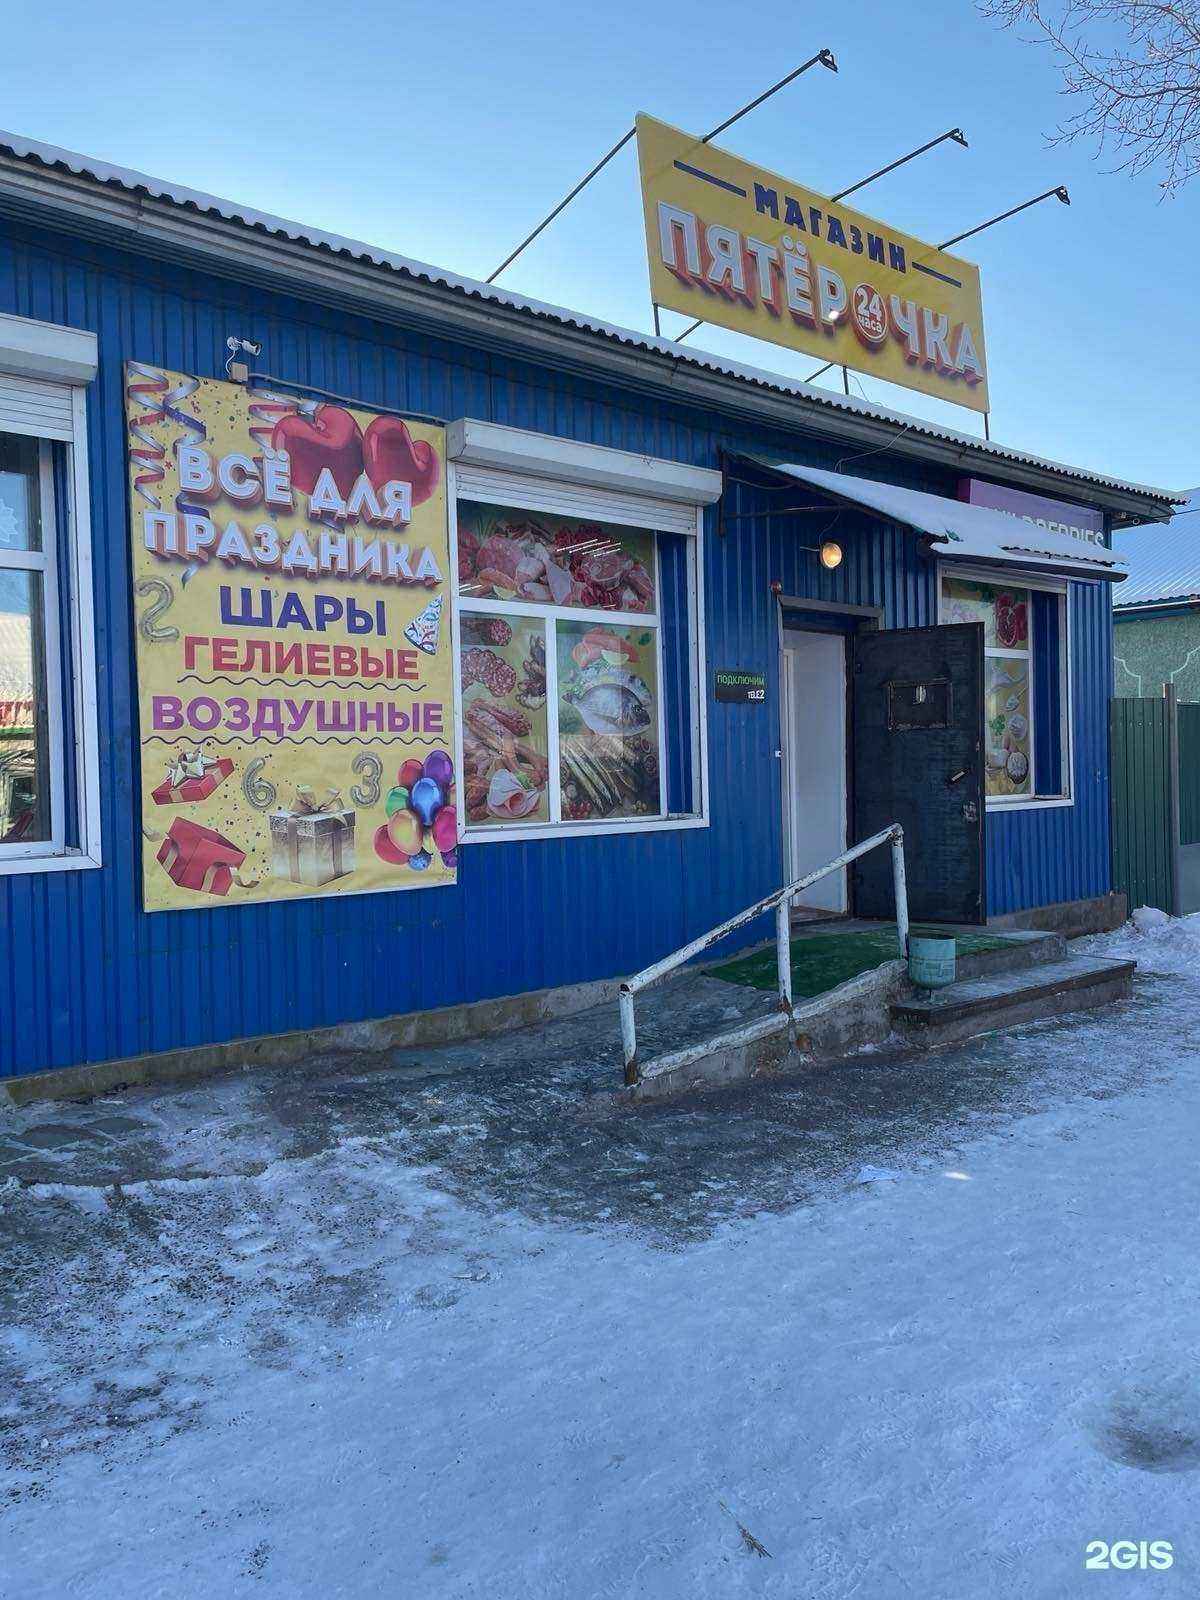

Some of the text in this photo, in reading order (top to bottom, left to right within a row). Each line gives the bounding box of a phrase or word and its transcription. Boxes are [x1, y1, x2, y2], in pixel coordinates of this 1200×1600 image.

[753, 182, 907, 274] МАГАЗИН
[856, 287, 883, 322] 24
[176, 444, 413, 525] ВСЁ ДЛЯ
[143, 511, 443, 585] ПРАЗДНИКА
[219, 586, 387, 636] ШАРЫ
[184, 635, 419, 680] ГЕЛИЕВЫЕ
[152, 695, 443, 738] ВОЗДУШНЫЕ
